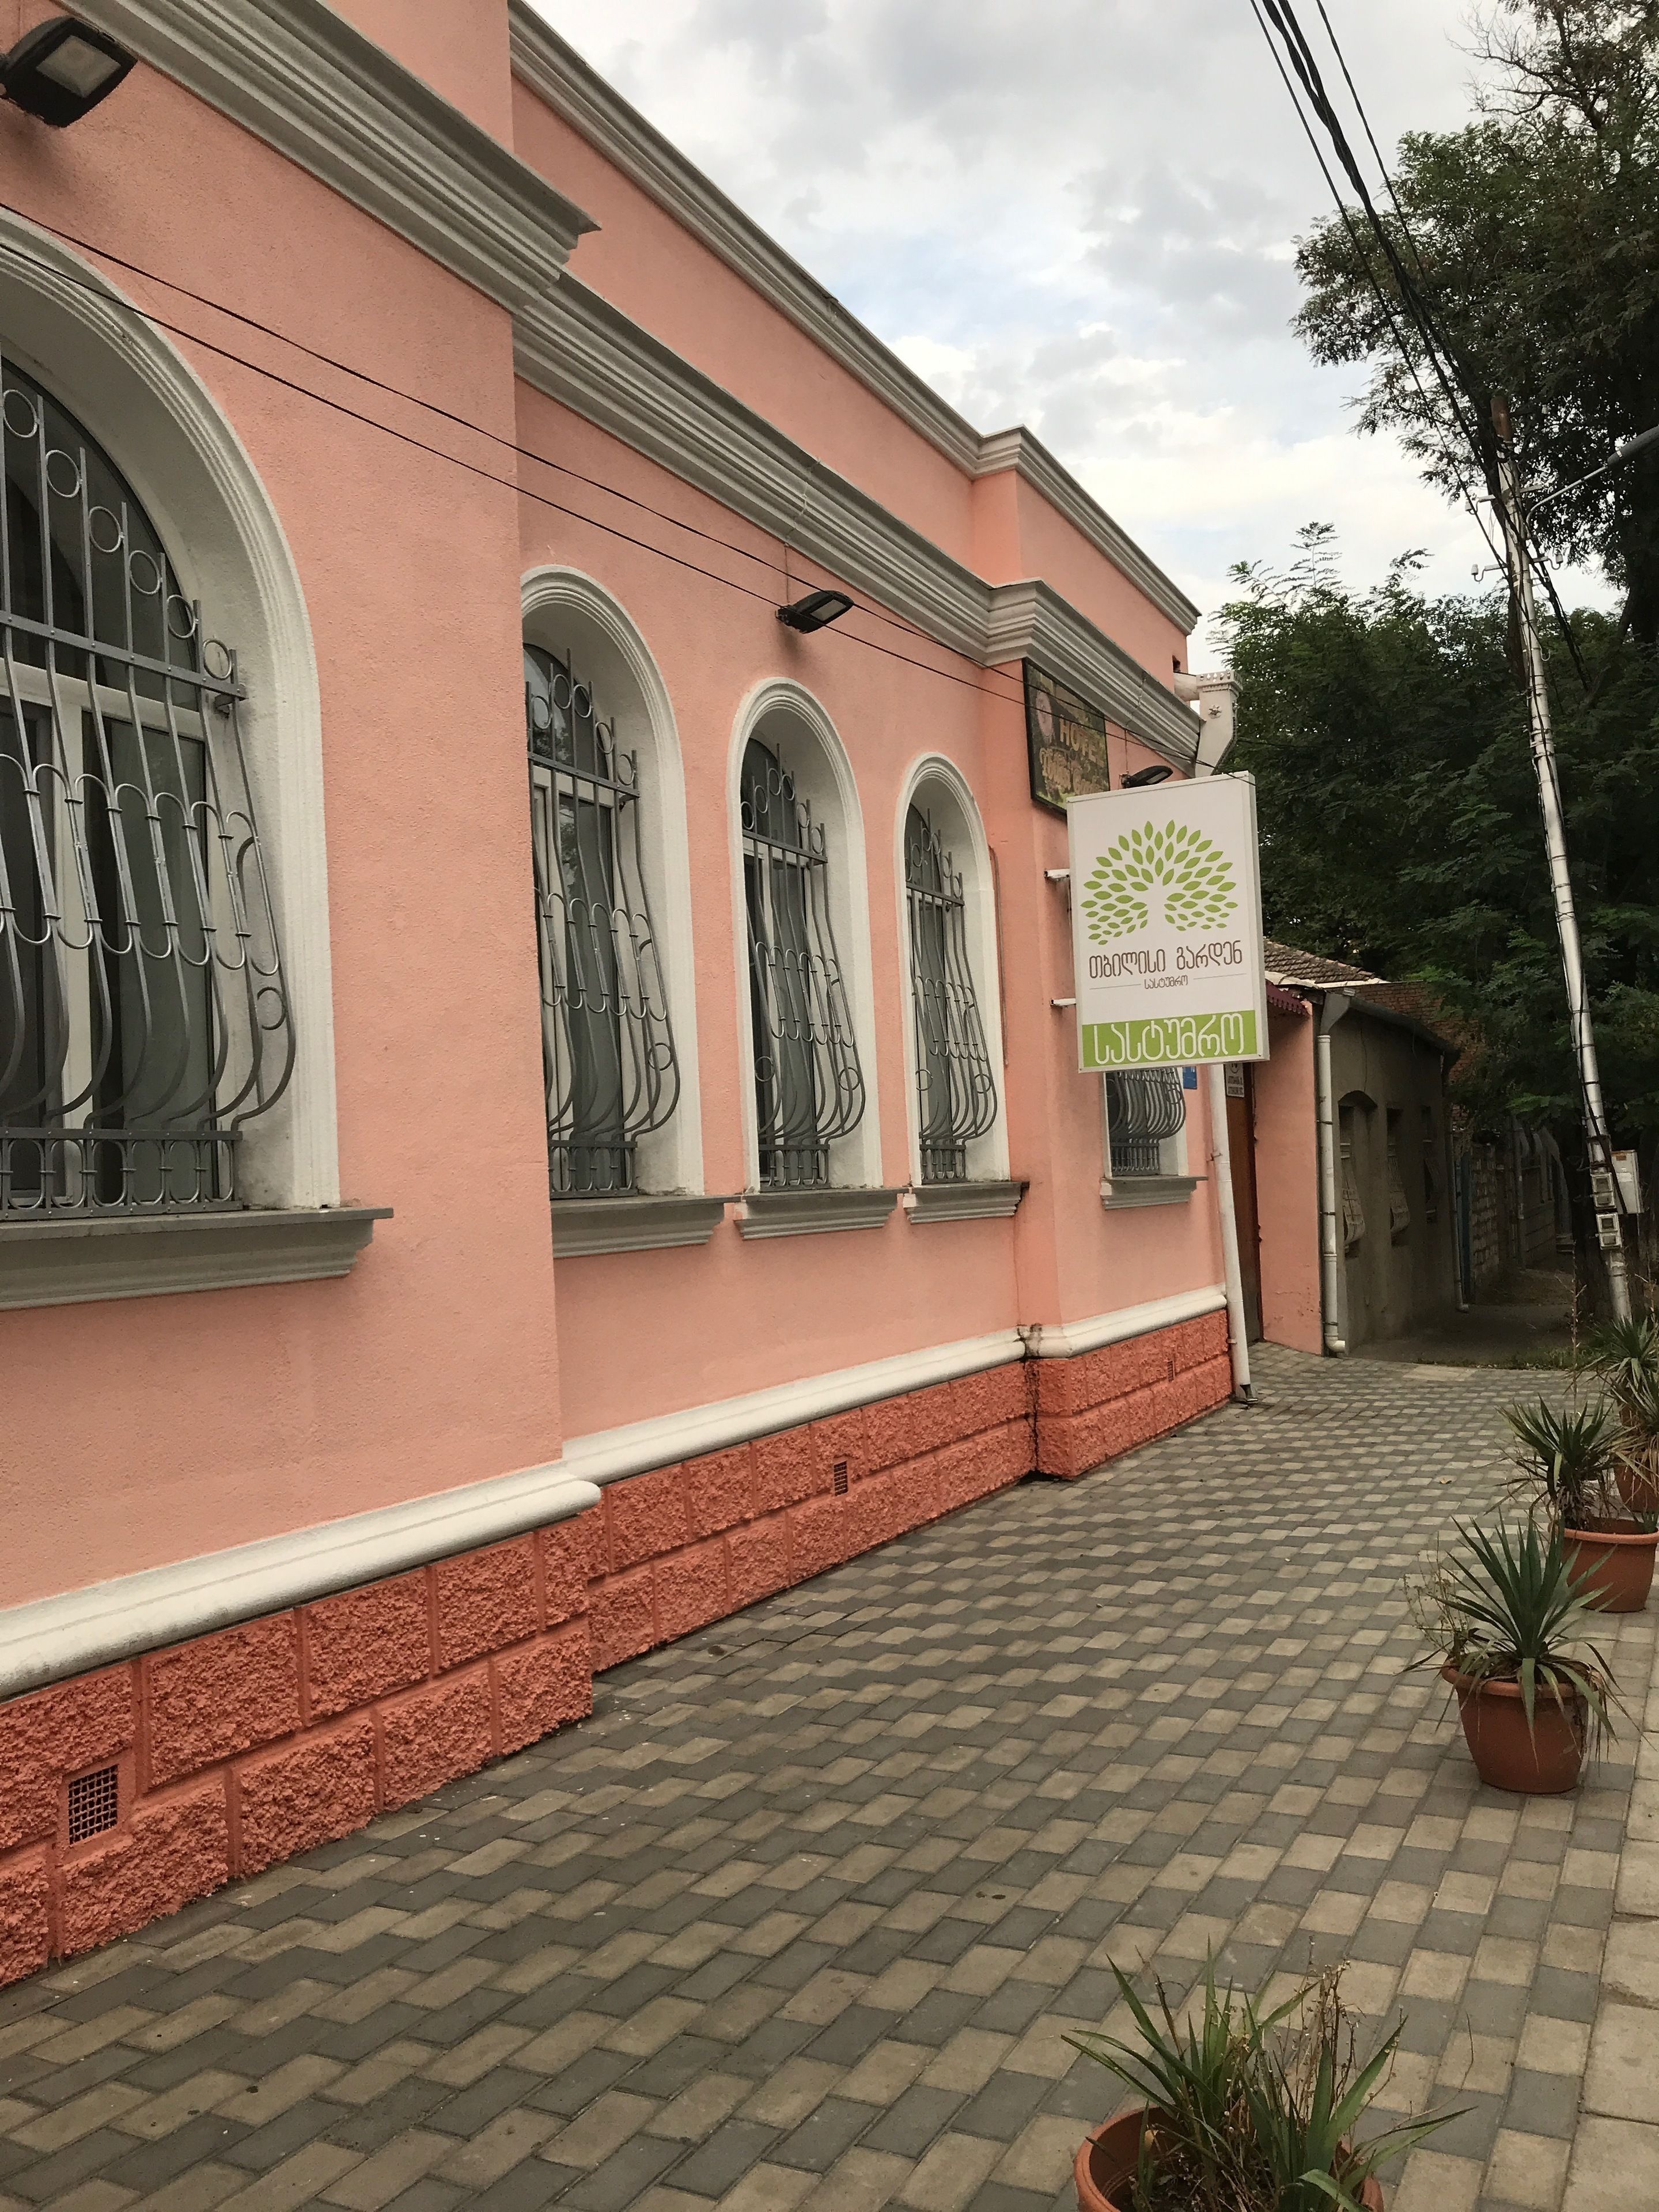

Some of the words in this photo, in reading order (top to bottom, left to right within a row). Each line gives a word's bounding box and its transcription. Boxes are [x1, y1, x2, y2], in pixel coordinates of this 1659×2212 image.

[1089, 949, 1166, 979] თბილისი
[1176, 940, 1243, 970] გარდენ
[1143, 975, 1188, 990] სასტუმრო
[1093, 1012, 1245, 1065] სასტუმრო
